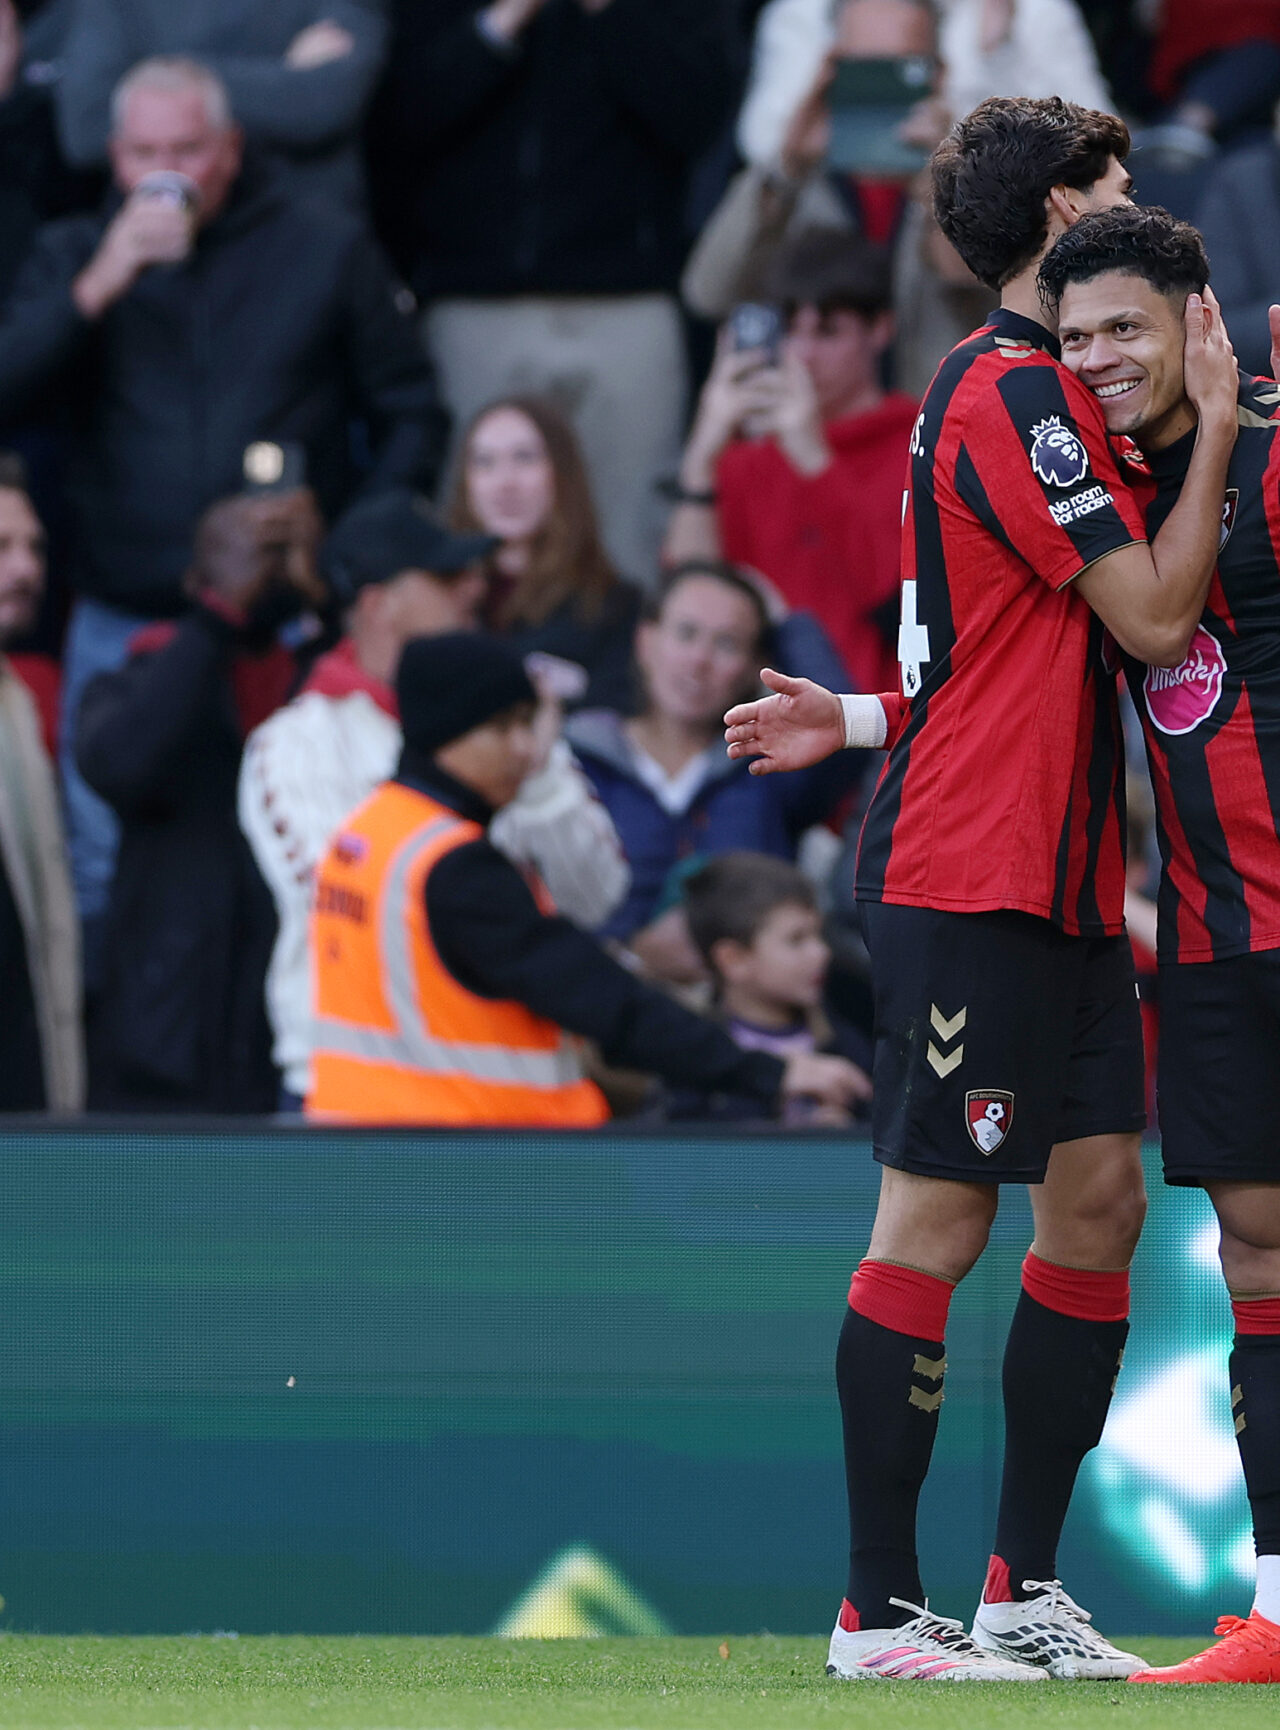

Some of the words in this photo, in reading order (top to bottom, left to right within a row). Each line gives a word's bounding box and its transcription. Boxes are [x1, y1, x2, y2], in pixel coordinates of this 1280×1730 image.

[1048, 501, 1070, 518] No
[1070, 486, 1104, 507] room
[1054, 510, 1074, 526] for
[1074, 493, 1114, 518] racism
